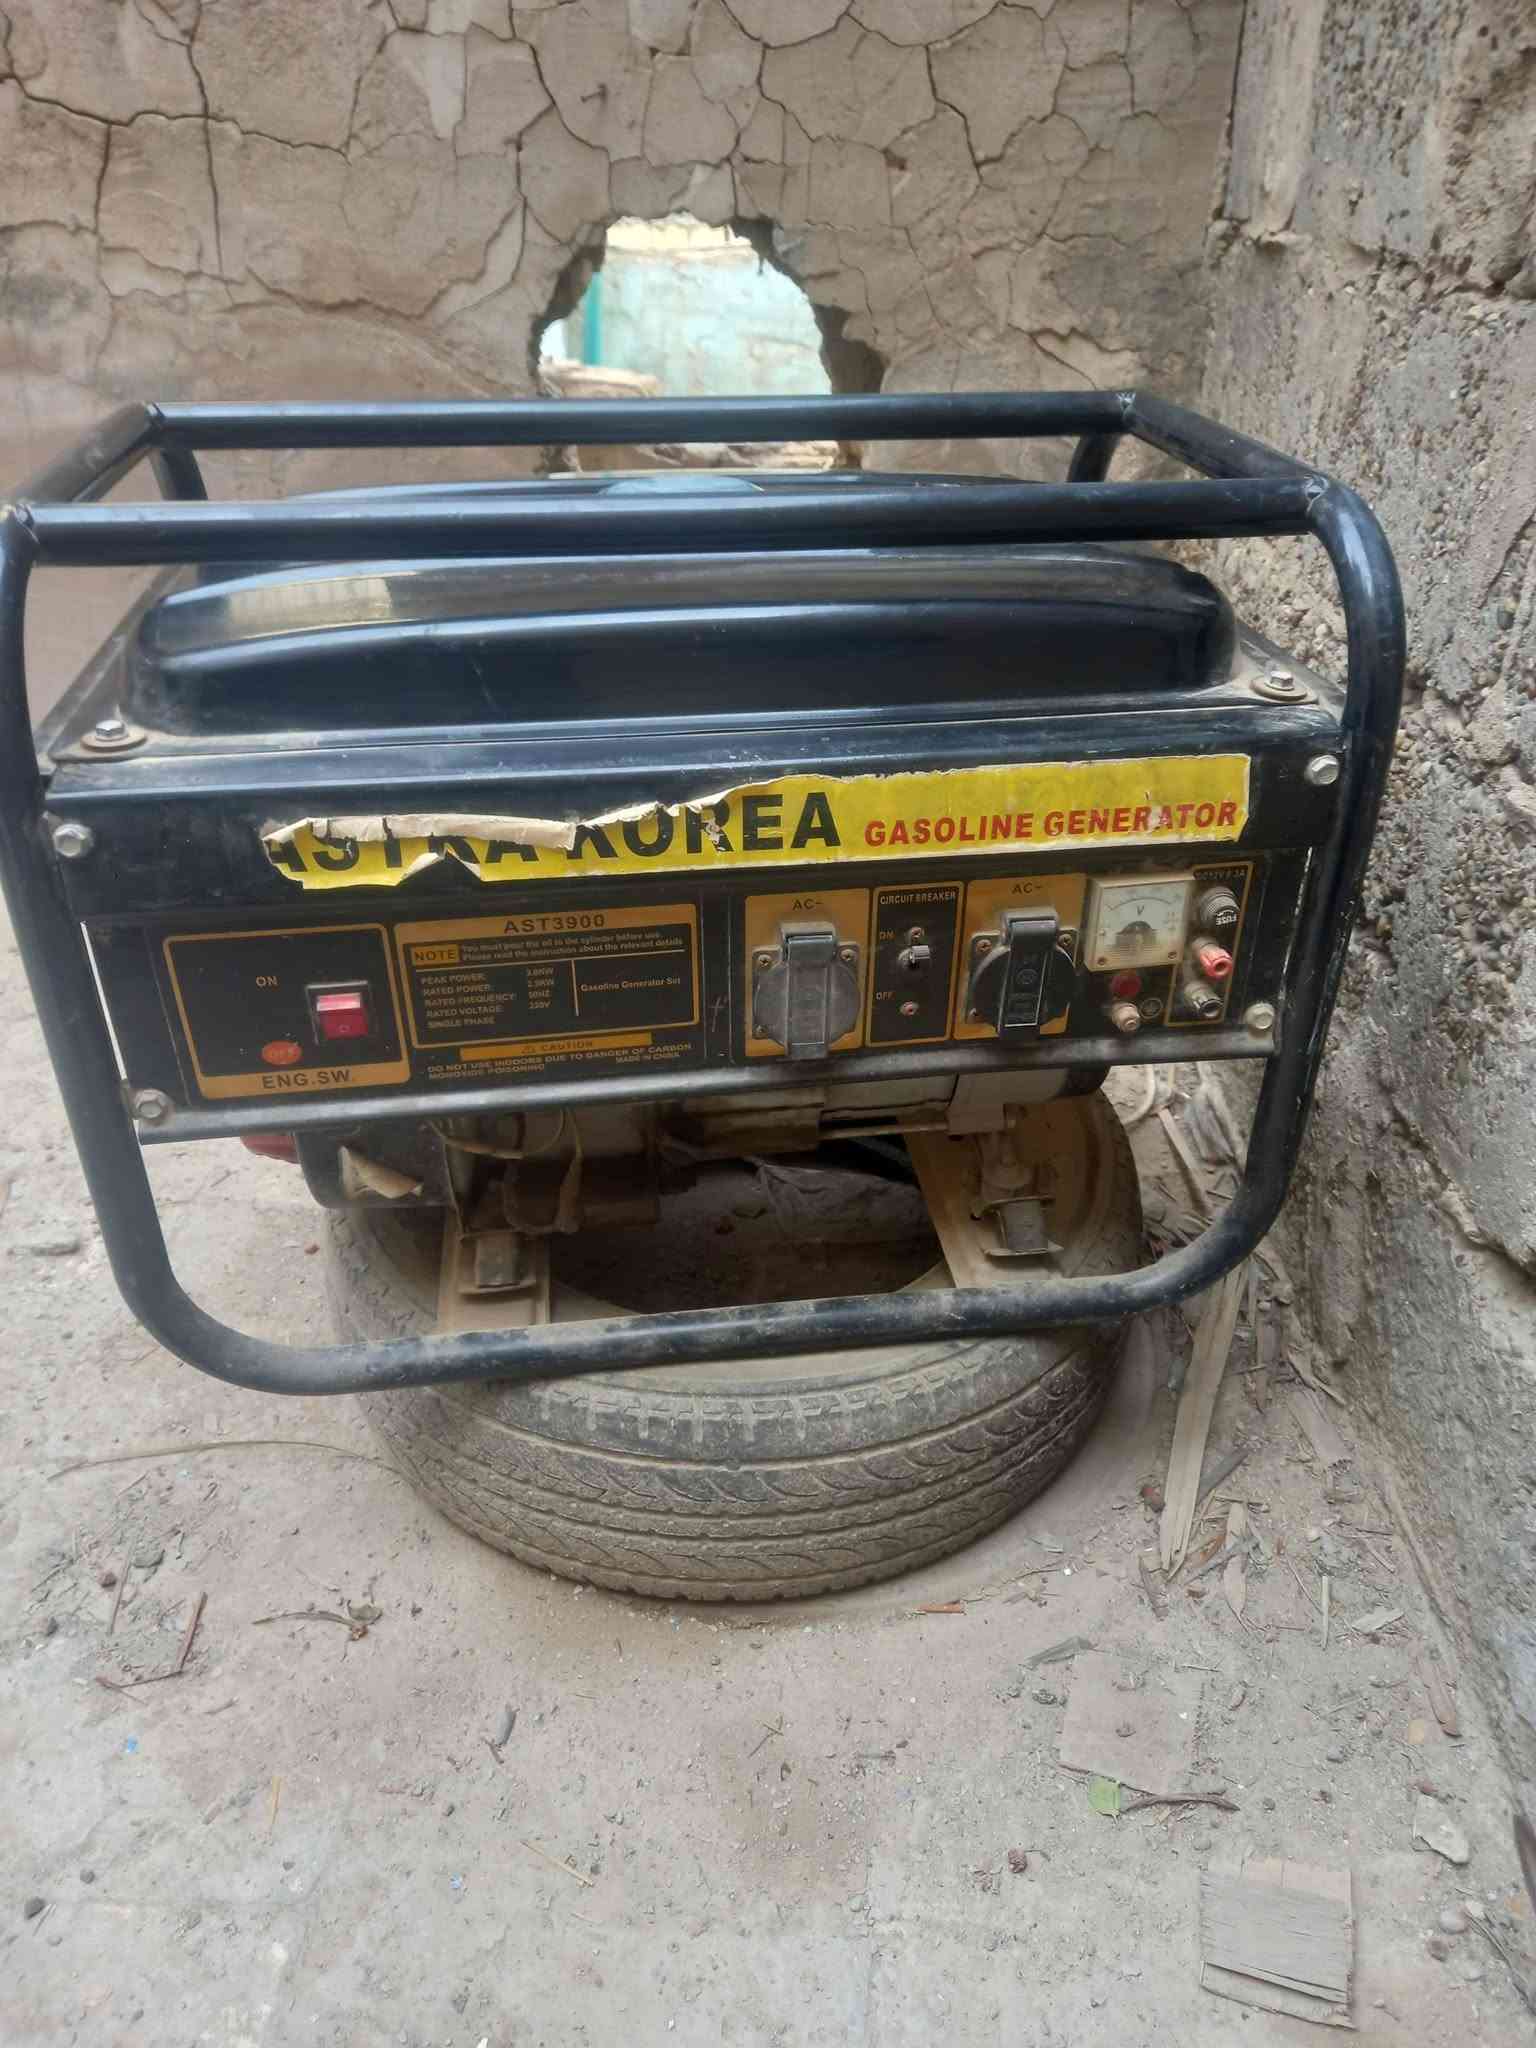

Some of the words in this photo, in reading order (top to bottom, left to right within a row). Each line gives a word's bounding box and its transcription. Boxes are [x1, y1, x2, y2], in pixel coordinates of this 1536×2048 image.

[863, 812, 1035, 847] GASOLINE
[1043, 800, 1238, 837] GENERATOR
[880, 894, 914, 905] CIRCUIT
[915, 892, 956, 903] BREAKER
[503, 914, 606, 934] AST3900
[414, 949, 457, 962] NOTE
[255, 975, 278, 988] ON
[580, 982, 620, 992] Gasoline
[621, 979, 664, 989] Generator
[543, 1040, 593, 1052] CAUTION
[446, 1062, 469, 1073] NOT
[545, 1054, 567, 1064] DUE
[569, 1053, 583, 1061] TO
[586, 1049, 629, 1060] DANGER
[647, 1043, 691, 1055] CARBON
[262, 1069, 351, 1090] ENG.SW
